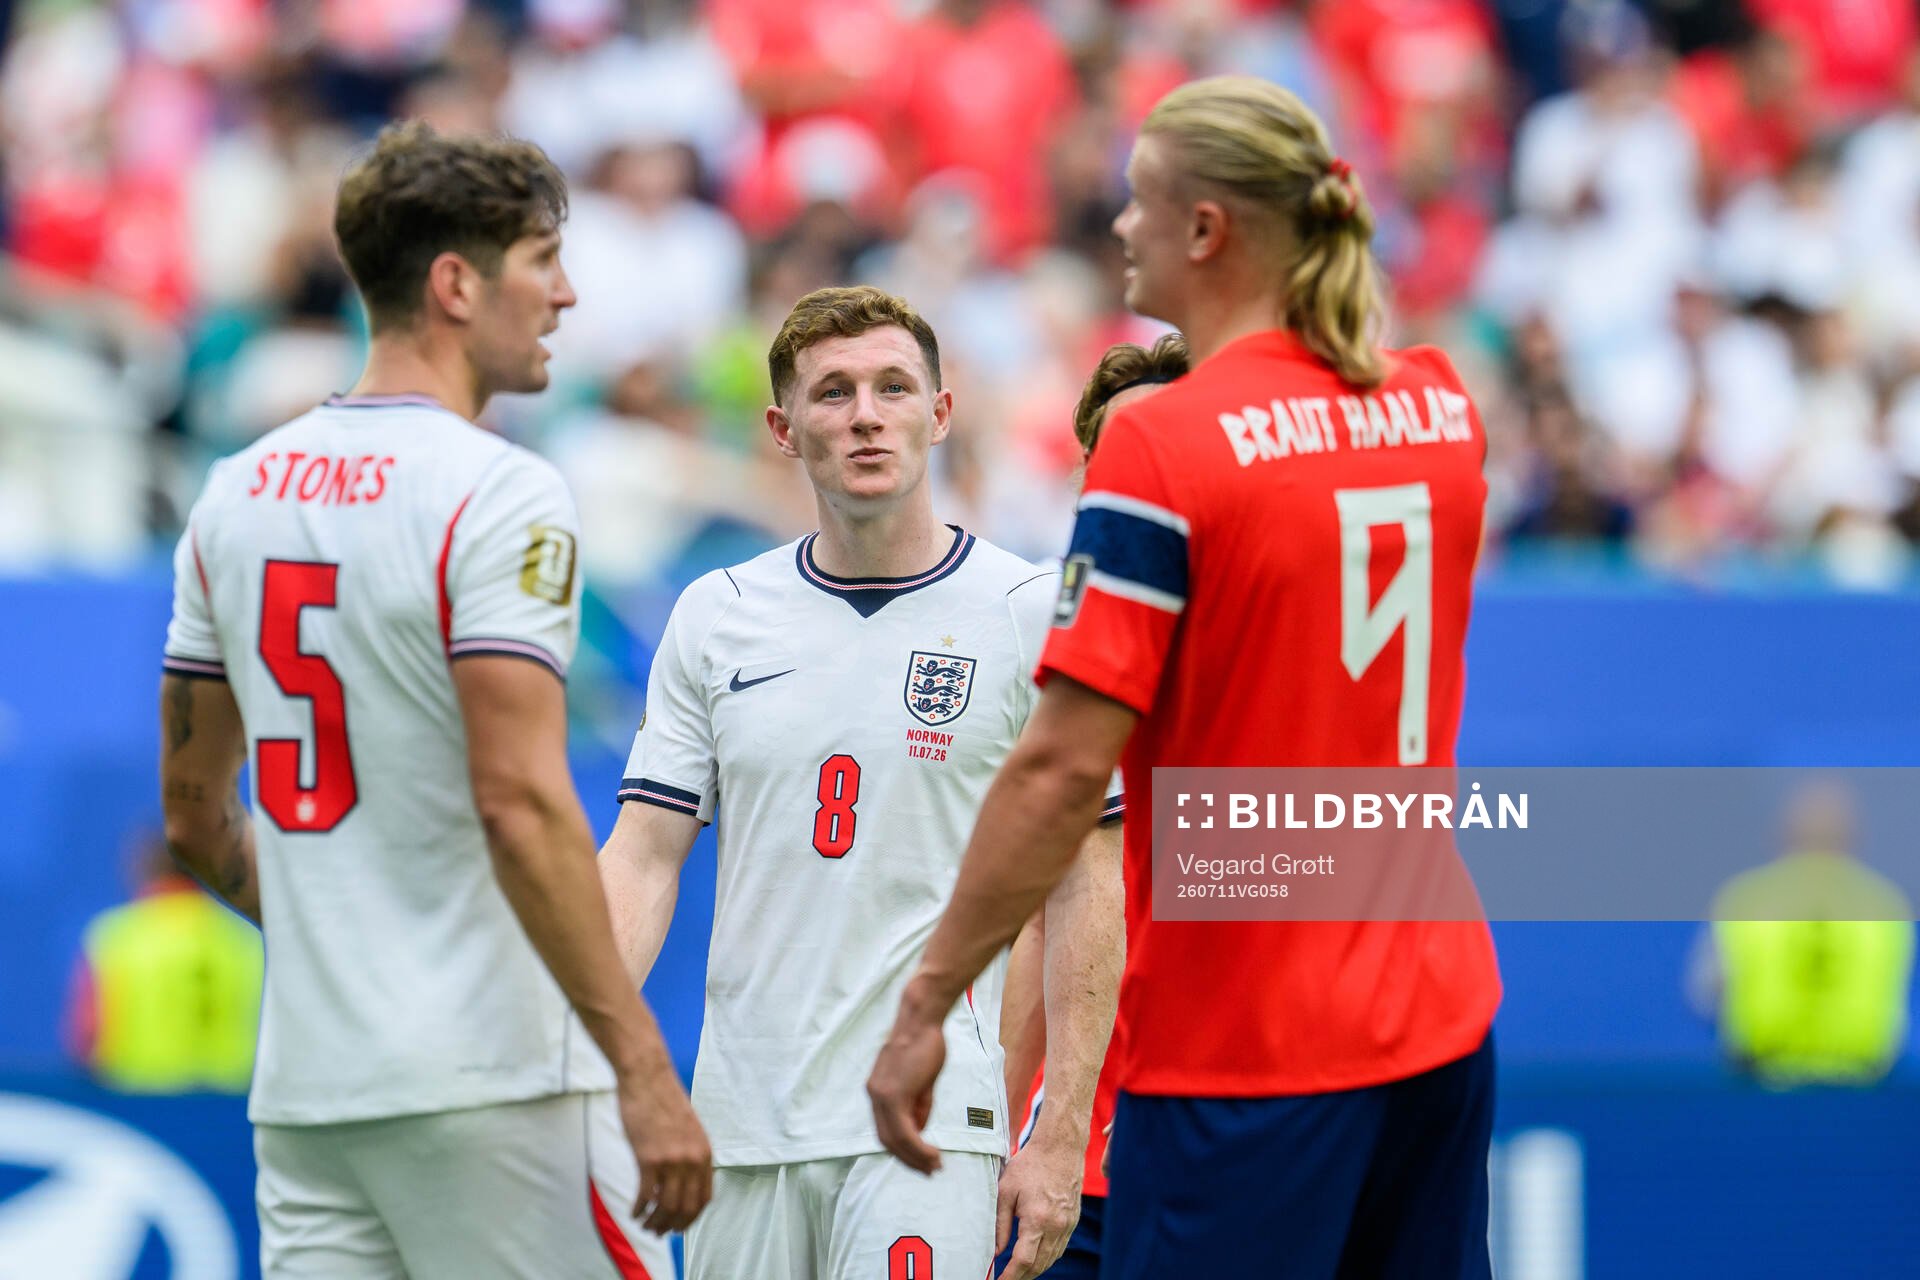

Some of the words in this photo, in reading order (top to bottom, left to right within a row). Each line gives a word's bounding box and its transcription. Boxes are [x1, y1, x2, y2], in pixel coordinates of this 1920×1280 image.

[1218, 397, 1337, 466] BRAUT
[249, 452, 397, 506] STONES
[1334, 482, 1432, 766] 9
[256, 559, 358, 832] 5
[906, 728, 954, 747] NORWAY
[908, 745, 947, 761] 11.07.26
[813, 753, 862, 859] 8
